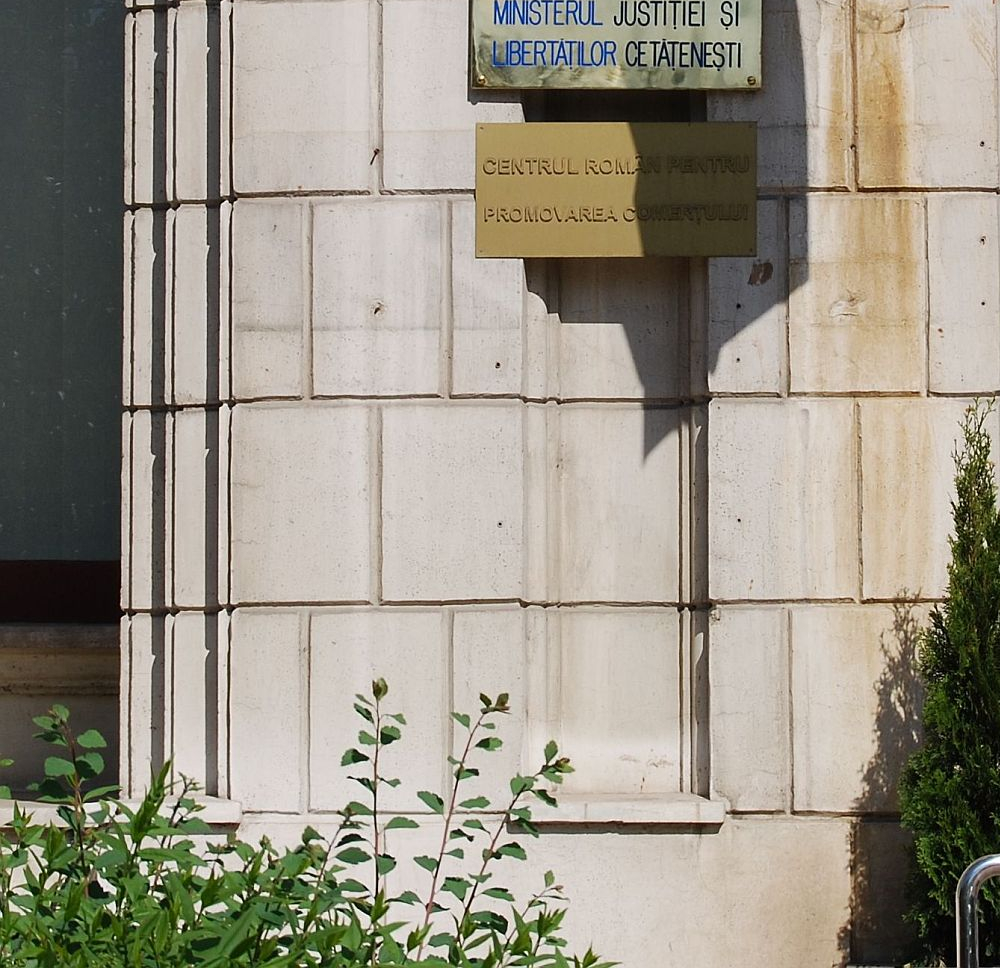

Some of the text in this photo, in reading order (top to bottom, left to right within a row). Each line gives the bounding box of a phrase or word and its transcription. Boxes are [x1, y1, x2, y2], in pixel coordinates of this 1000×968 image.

[493, 0, 603, 26] MINISTERUL
[482, 157, 579, 176] CENTRUL
[667, 155, 750, 175] PENTRU
[483, 205, 618, 223] PROMOVAREA
